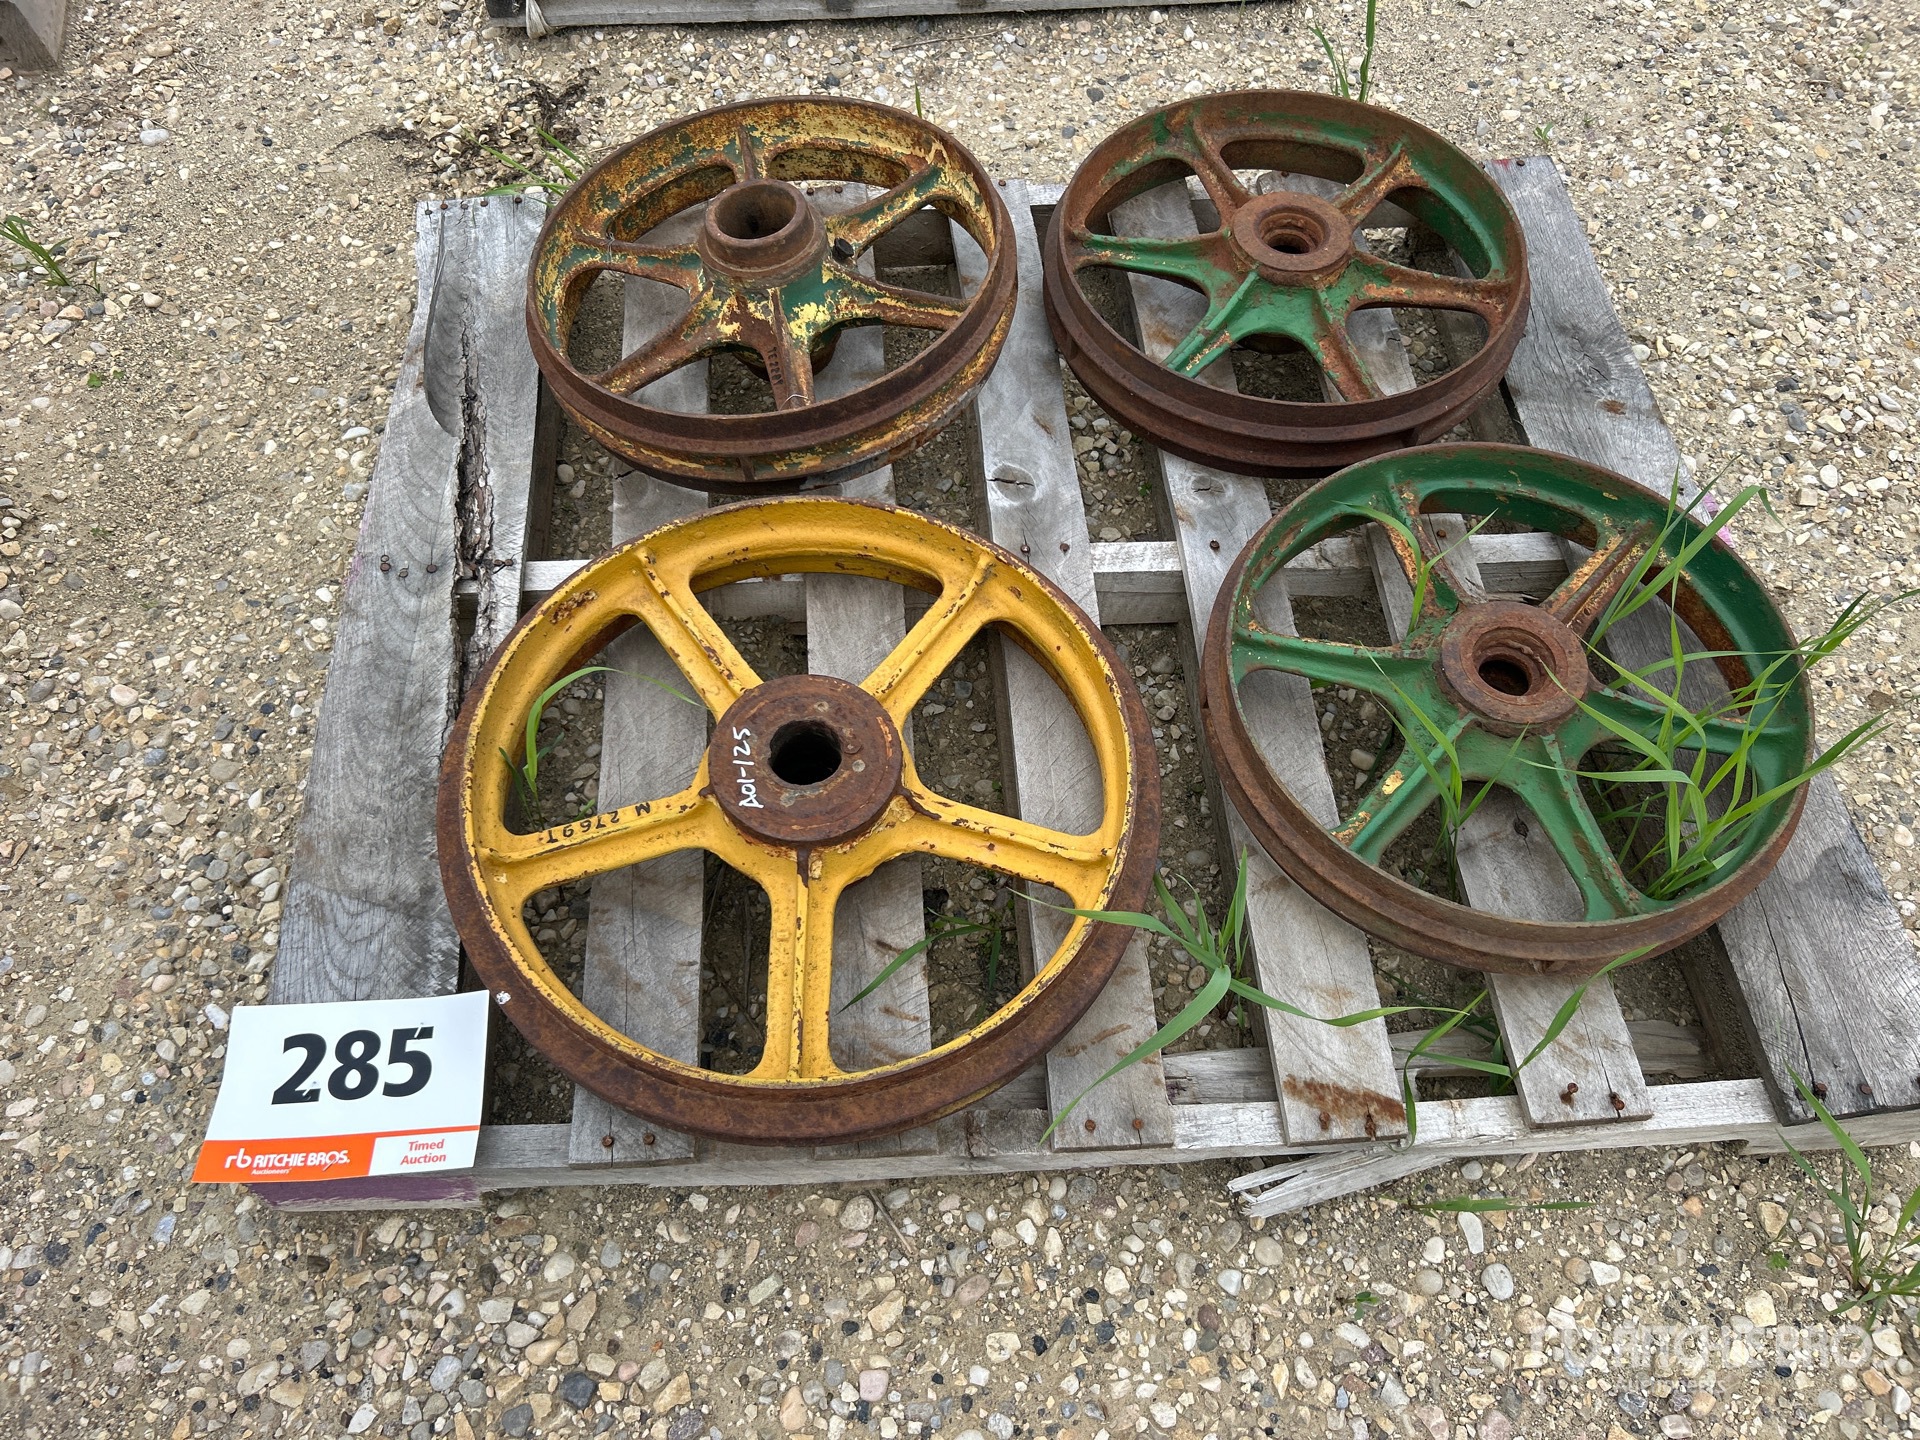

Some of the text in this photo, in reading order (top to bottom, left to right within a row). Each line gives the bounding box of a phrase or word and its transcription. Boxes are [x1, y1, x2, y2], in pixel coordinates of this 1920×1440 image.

[732, 726, 764, 809] A01-125
[540, 801, 652, 843] M 2769T
[271, 1026, 435, 1105] 285
[400, 1152, 447, 1166] Auction
[408, 1138, 446, 1152] Timed
[252, 1153, 306, 1168] RITCHIE
